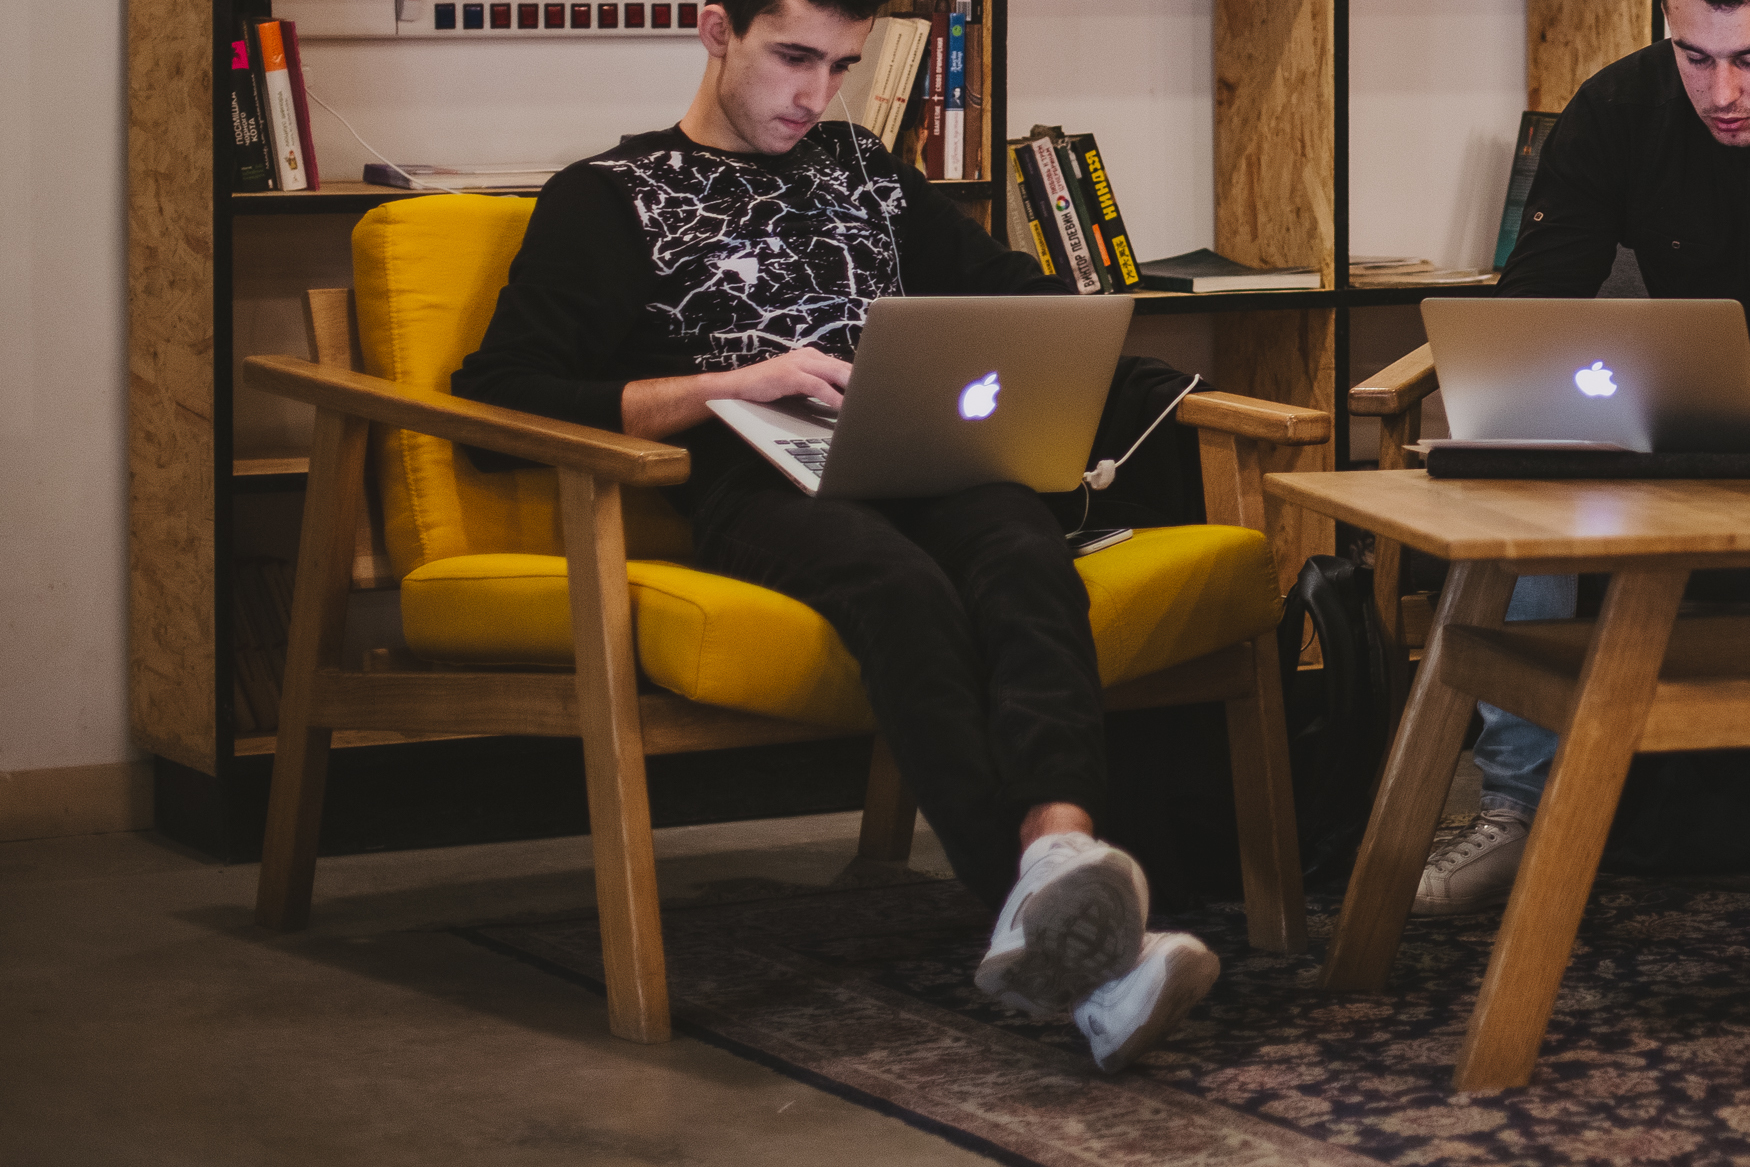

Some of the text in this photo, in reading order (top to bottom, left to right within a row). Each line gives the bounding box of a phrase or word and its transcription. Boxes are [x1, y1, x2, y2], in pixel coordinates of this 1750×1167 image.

[1045, 168, 1057, 195] ЛЮБОВЬ
[1085, 149, 1118, 221] НИНДЗЯ
[1061, 212, 1095, 288] ВИКТОР ПЕЛЕВИН
